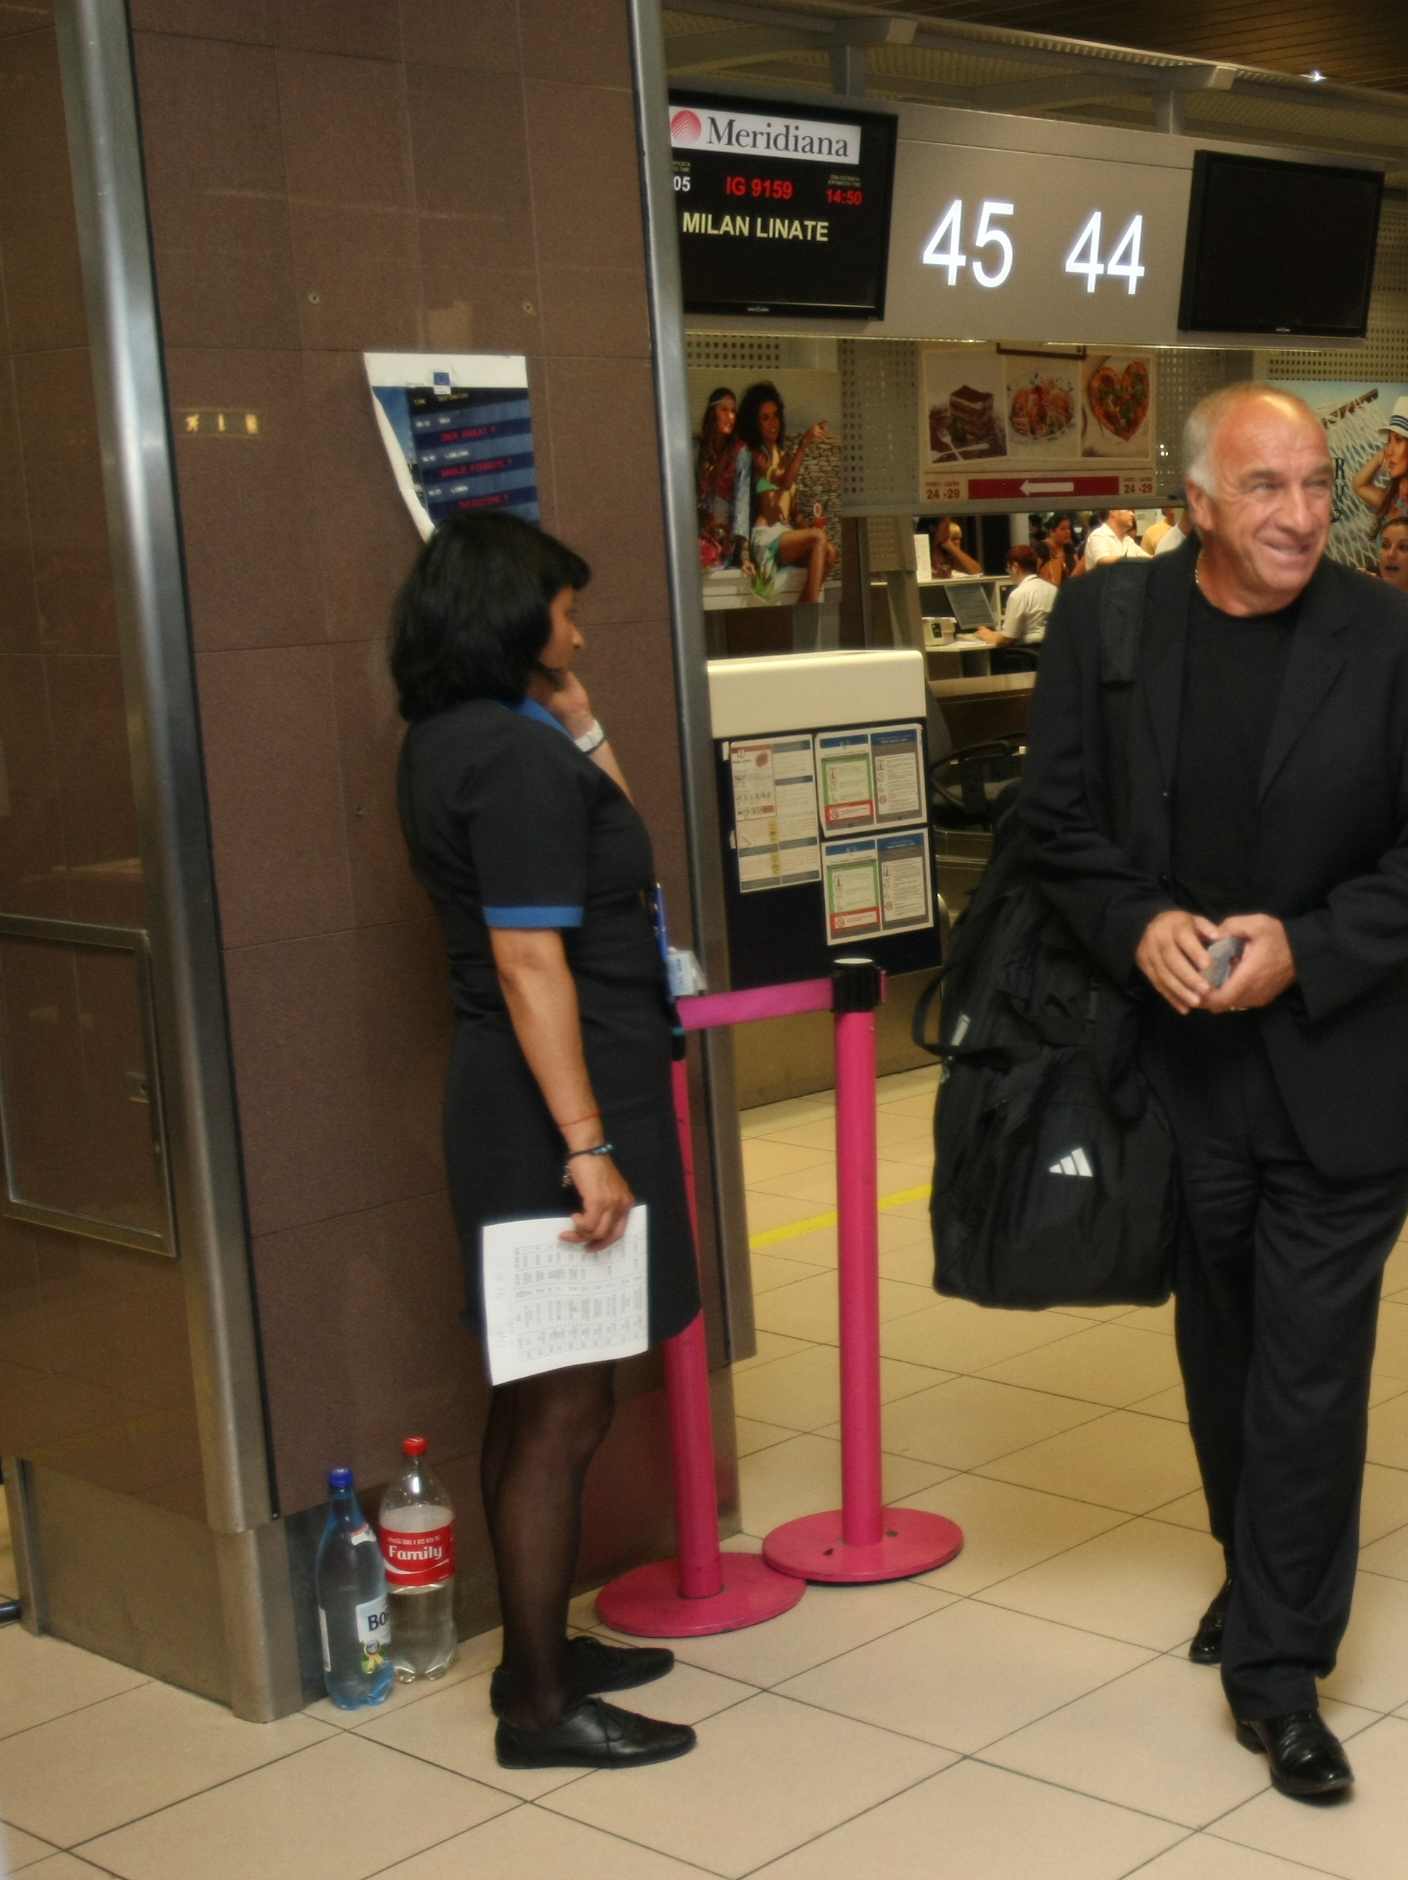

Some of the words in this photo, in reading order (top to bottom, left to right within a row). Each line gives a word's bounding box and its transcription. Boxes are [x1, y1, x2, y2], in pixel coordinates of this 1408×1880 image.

[706, 116, 849, 158] Meridiana
[673, 175, 691, 192] 05
[725, 176, 746, 196] IG
[752, 178, 794, 200] 9159
[826, 189, 863, 205] 14:50
[682, 212, 750, 237] MILAN
[756, 217, 829, 242] LINATE
[922, 199, 1015, 288] 45
[1064, 211, 1146, 295] 44
[926, 489, 940, 500] 24
[1124, 484, 1136, 494] 24
[388, 1544, 443, 1561] Family
